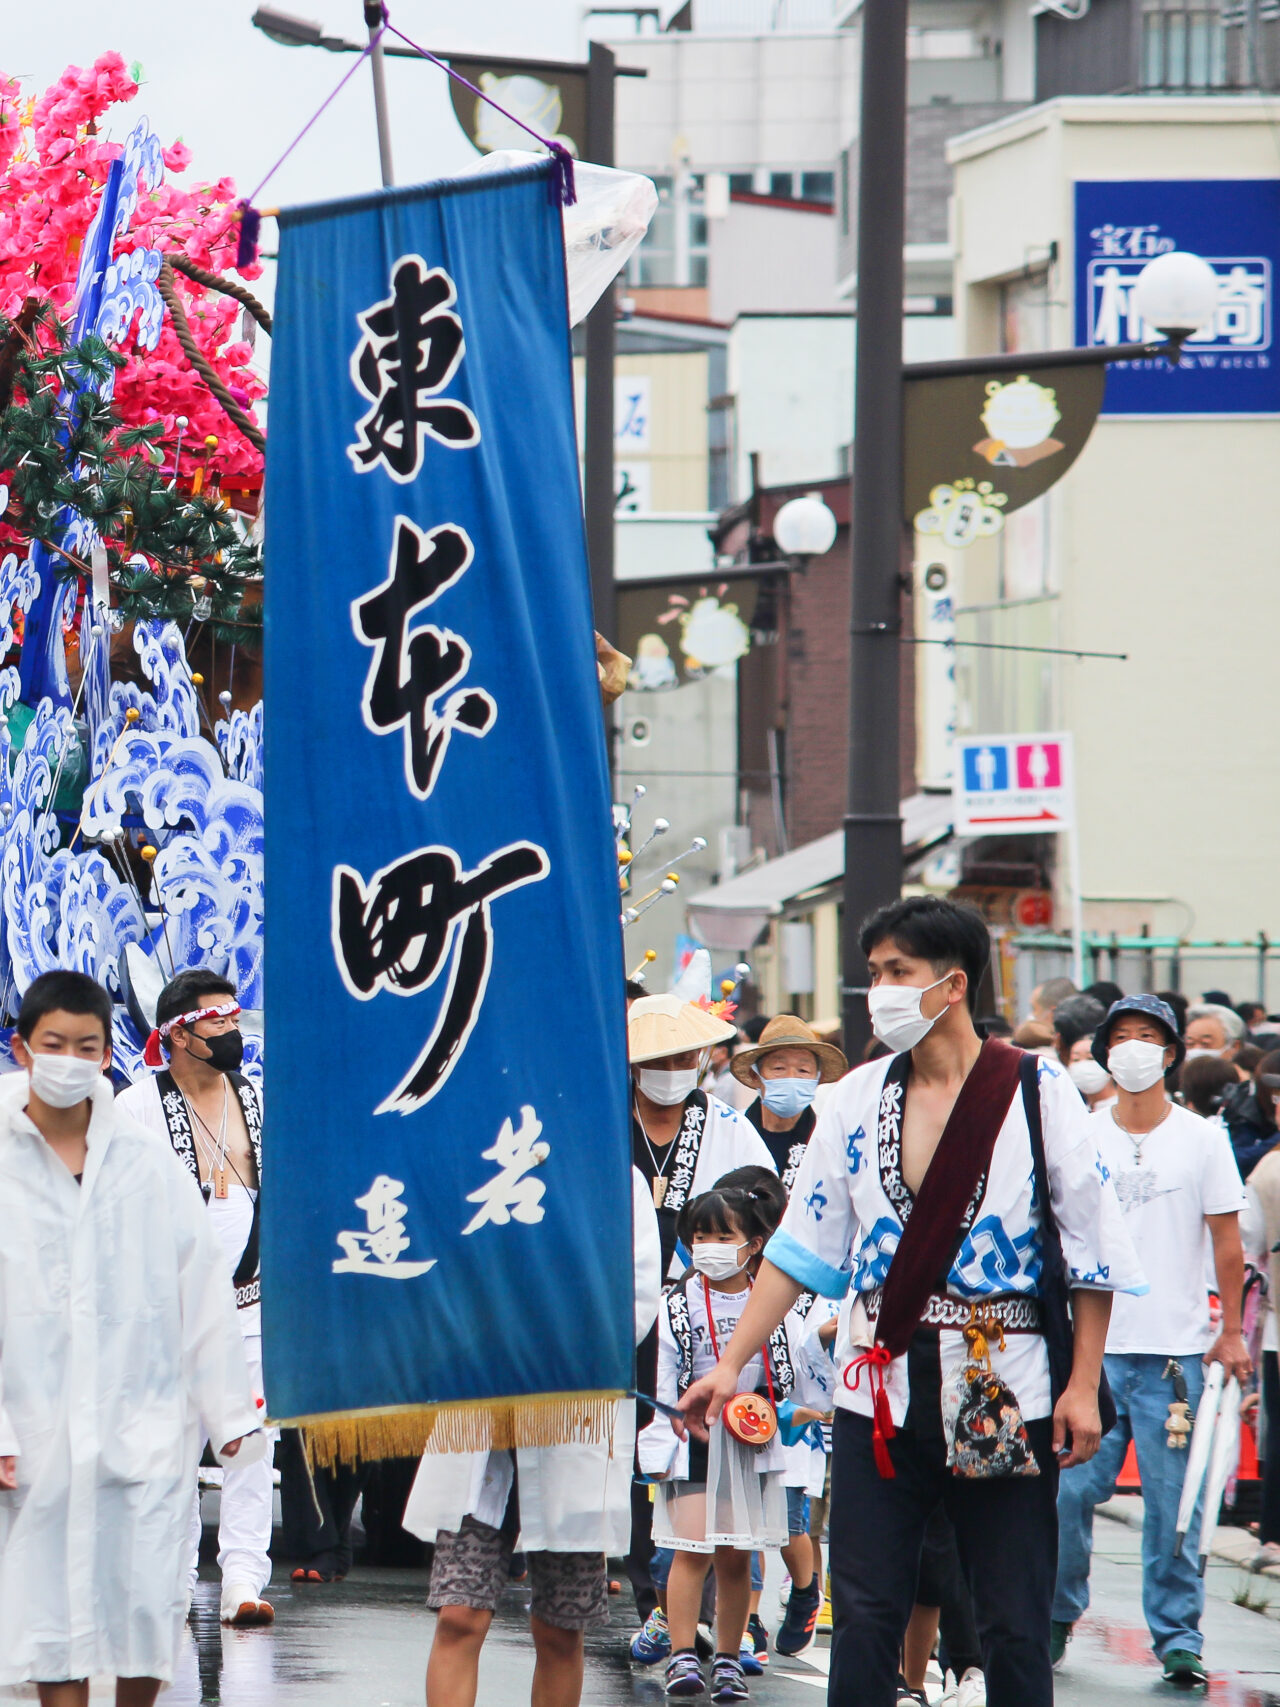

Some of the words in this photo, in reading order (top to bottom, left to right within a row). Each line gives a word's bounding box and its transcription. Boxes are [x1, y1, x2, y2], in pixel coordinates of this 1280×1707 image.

[1090, 224, 1176, 257] 宝石の
[332, 254, 550, 1116] 東本町
